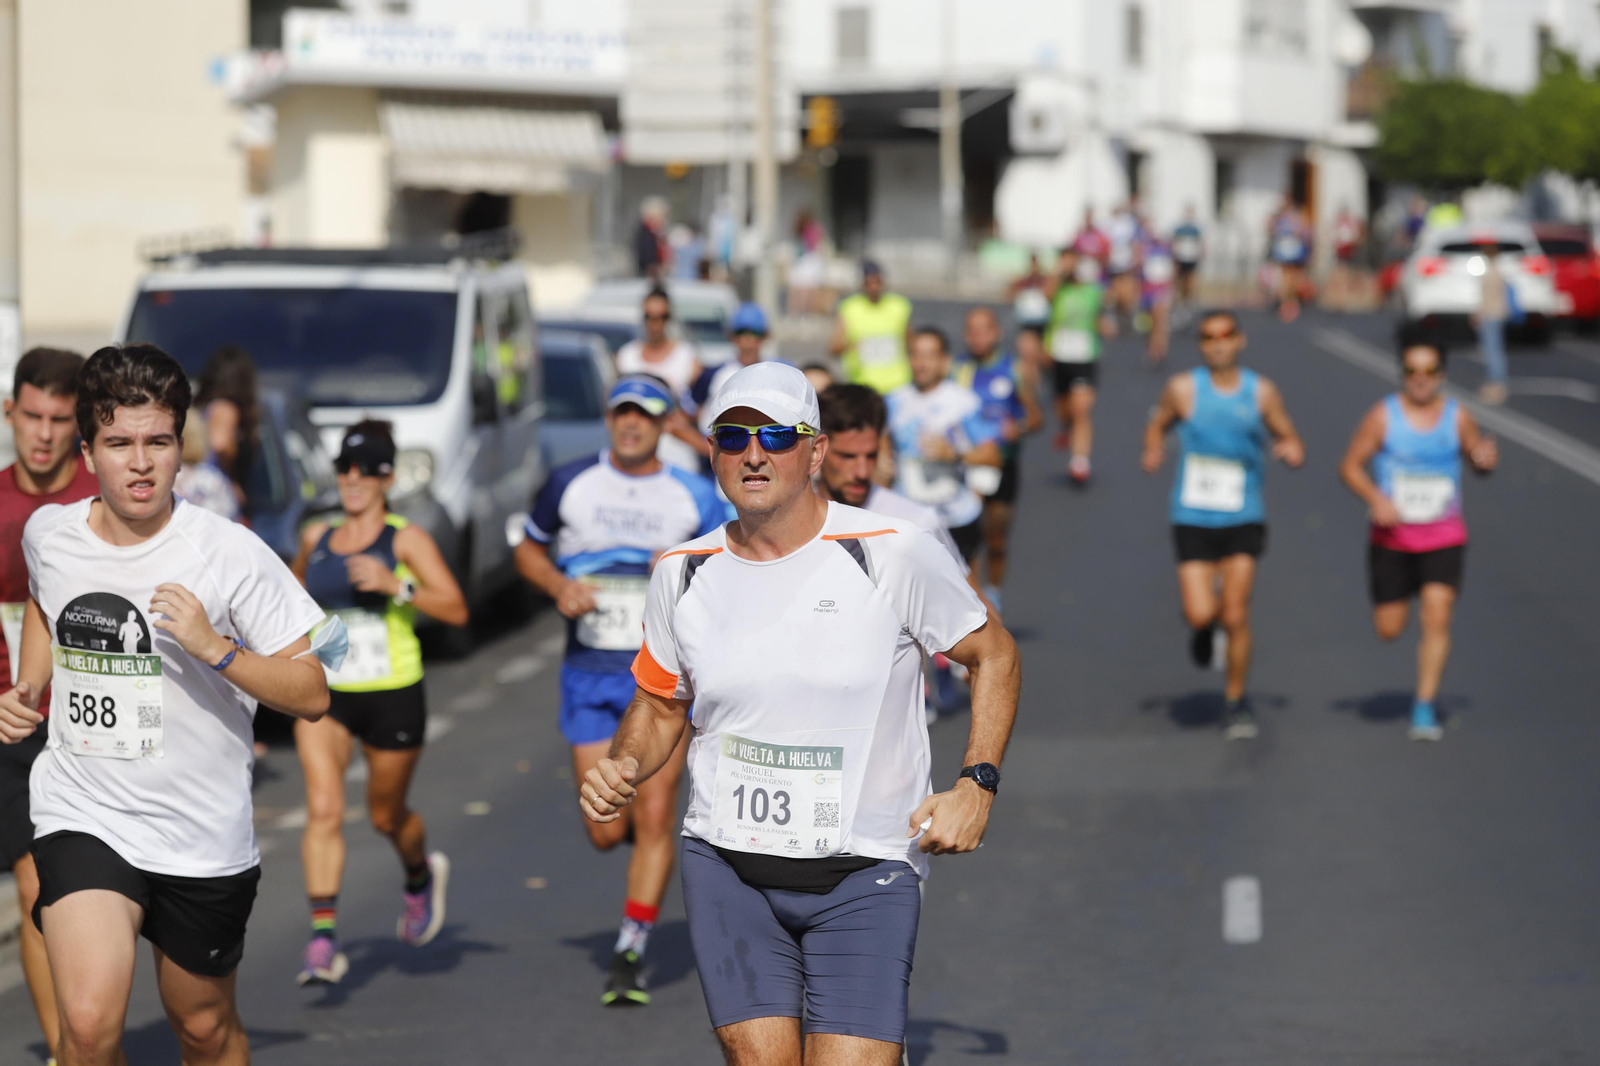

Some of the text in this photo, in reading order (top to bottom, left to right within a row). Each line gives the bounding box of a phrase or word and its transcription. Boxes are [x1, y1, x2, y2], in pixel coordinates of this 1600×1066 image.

[64, 611, 117, 628] NOCTURNA
[67, 653, 100, 673] VUELTA
[101, 659, 109, 674] A
[111, 659, 153, 675] HUELVA
[73, 674, 99, 684] PABLO
[69, 691, 117, 729] 588
[726, 740, 832, 767] 34 VUELTA A HUELVA
[730, 771, 792, 787] POLVORINOS GENTO
[741, 765, 775, 778] MIGUEL
[732, 784, 791, 826] 103
[737, 824, 762, 833] RUNNERS
[771, 828, 798, 836] PALMERA
